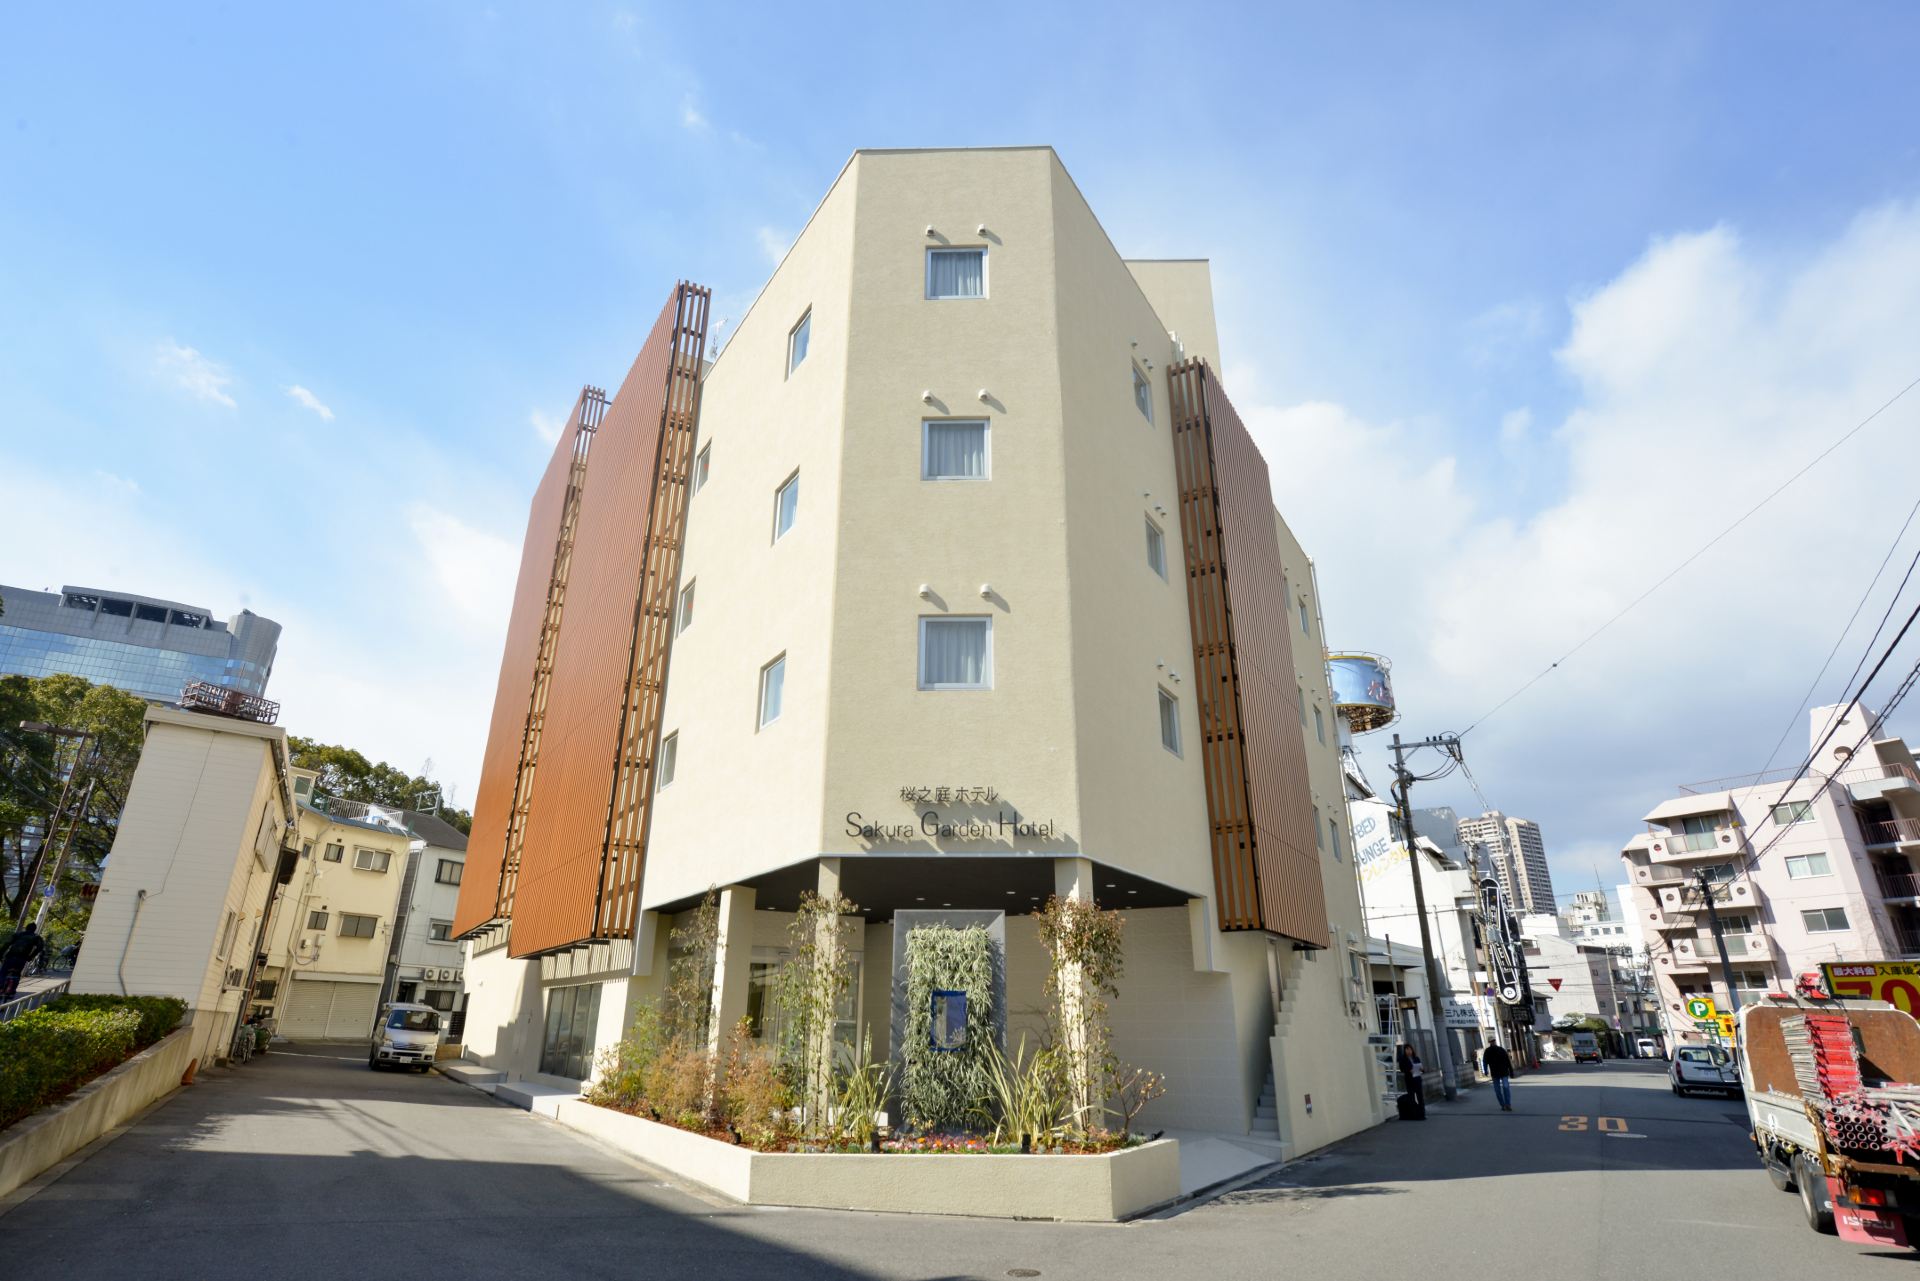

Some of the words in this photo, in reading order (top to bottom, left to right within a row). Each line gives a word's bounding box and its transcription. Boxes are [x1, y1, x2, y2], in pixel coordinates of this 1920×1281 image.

[899, 786, 999, 802] 桜之庭ホテル
[846, 811, 914, 838] Sakura
[920, 811, 992, 838] Garden
[999, 811, 1054, 837] Hotel
[1832, 966, 1876, 977] 最大料金
[1693, 1002, 1706, 1016] P
[1558, 1115, 1629, 1132] 30
